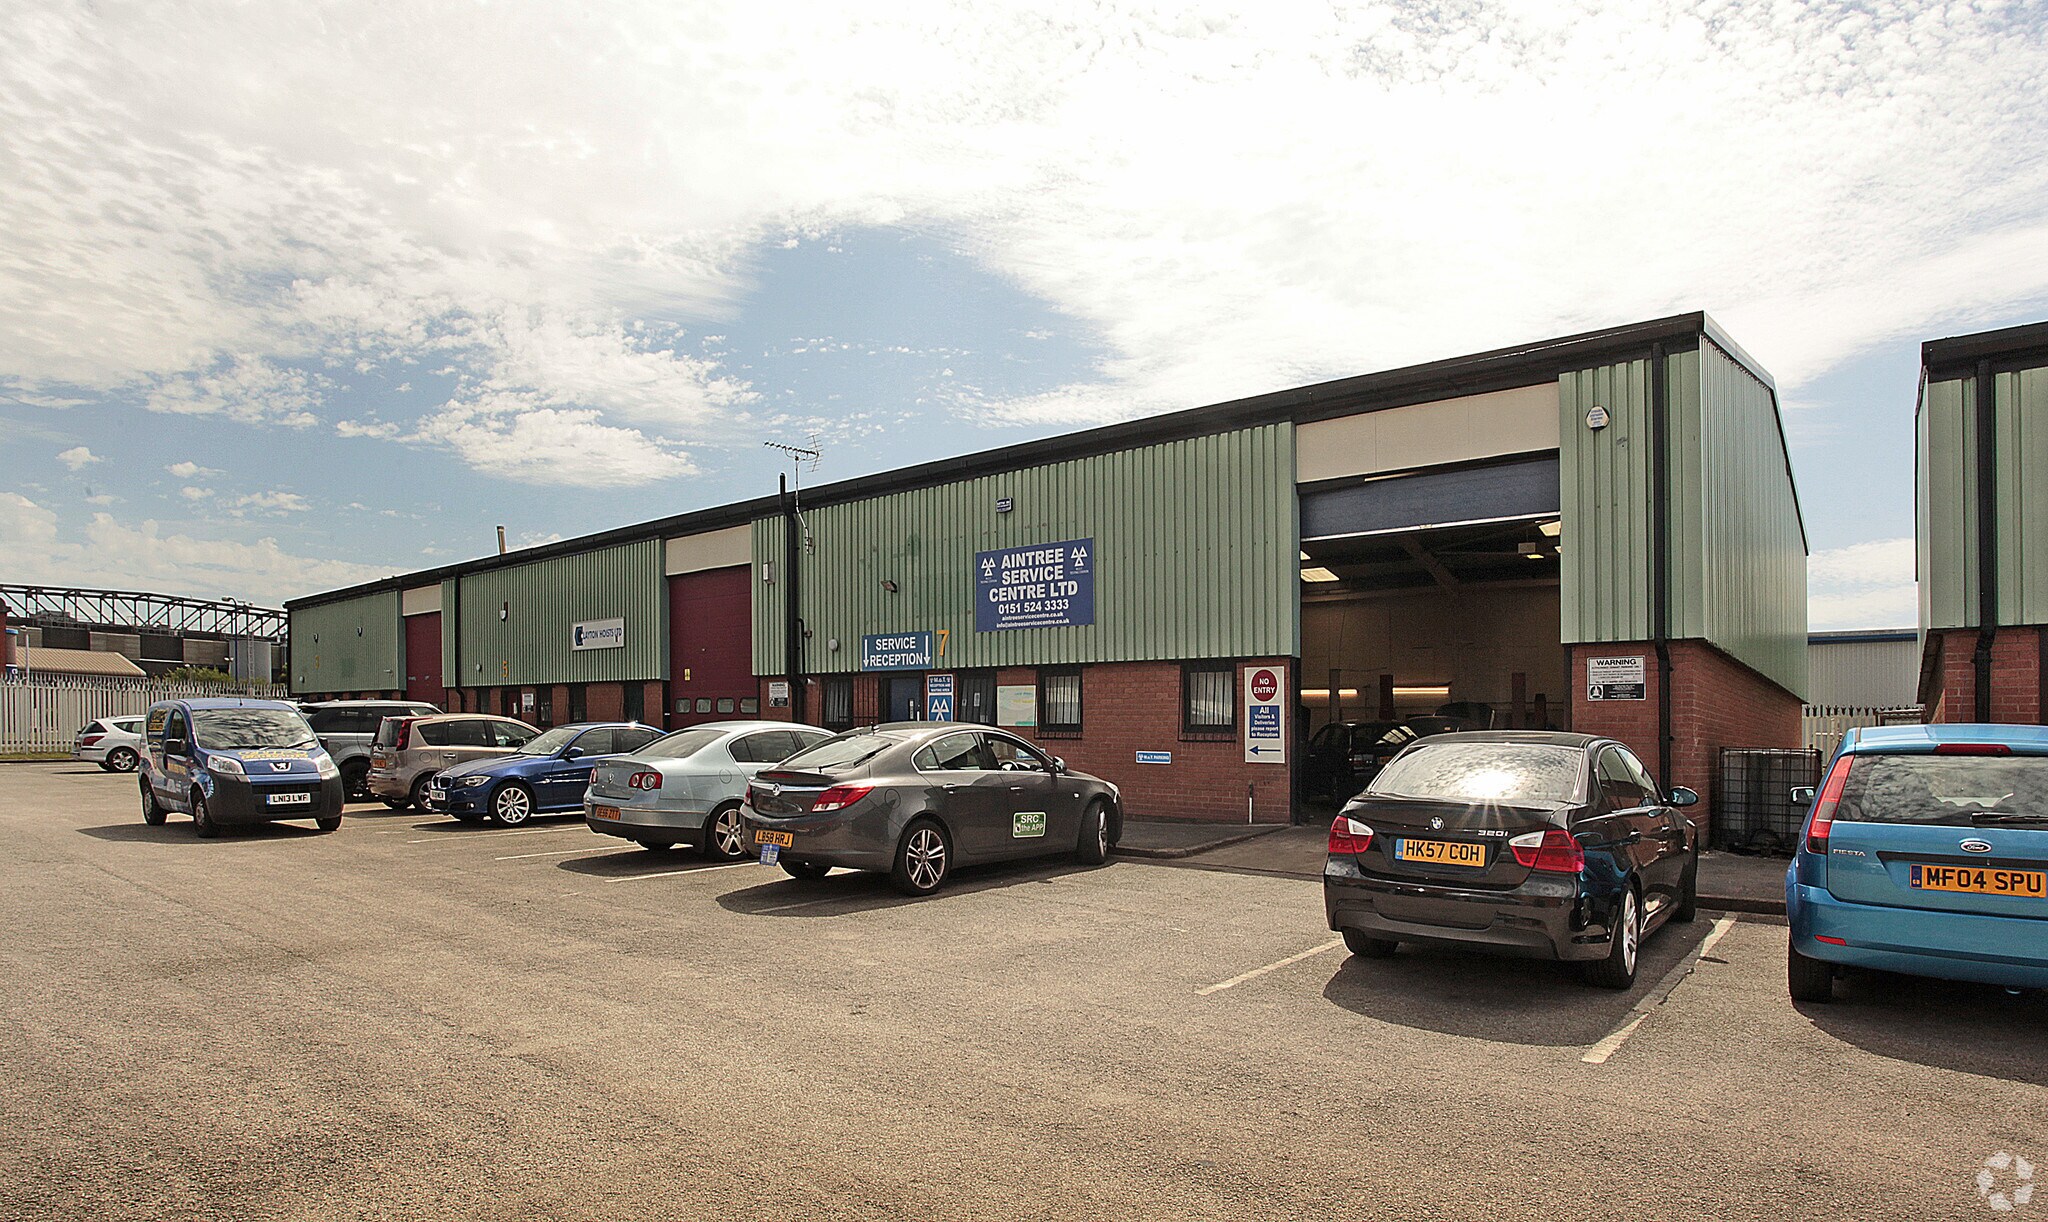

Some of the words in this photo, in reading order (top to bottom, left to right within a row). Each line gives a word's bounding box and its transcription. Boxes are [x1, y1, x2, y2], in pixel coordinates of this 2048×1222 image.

[1001, 548, 1064, 569] AINTREE
[1002, 565, 1064, 585] SERVICE
[989, 584, 1045, 602] CENTRE
[1050, 581, 1078, 597] LTD
[998, 603, 1021, 614] 0151
[1024, 601, 1041, 612] 524
[1045, 599, 1069, 610] 3333
[875, 637, 916, 650] SERVICE
[937, 630, 950, 656] 7
[869, 653, 923, 666] RECEPTION
[501, 660, 509, 677] 5
[1253, 686, 1275, 694] ENTRY
[1259, 706, 1270, 714] All
[292, 794, 307, 802] LWF
[1021, 814, 1039, 823] SRC
[1022, 824, 1031, 832] the
[1031, 823, 1044, 831] APP
[775, 833, 790, 845] HRJ
[1405, 841, 1445, 859] HK57
[1449, 844, 1480, 862] COH
[1833, 848, 1866, 857] FIESTA
[1926, 866, 1987, 889] MF04
[1994, 872, 2042, 893] SPU
